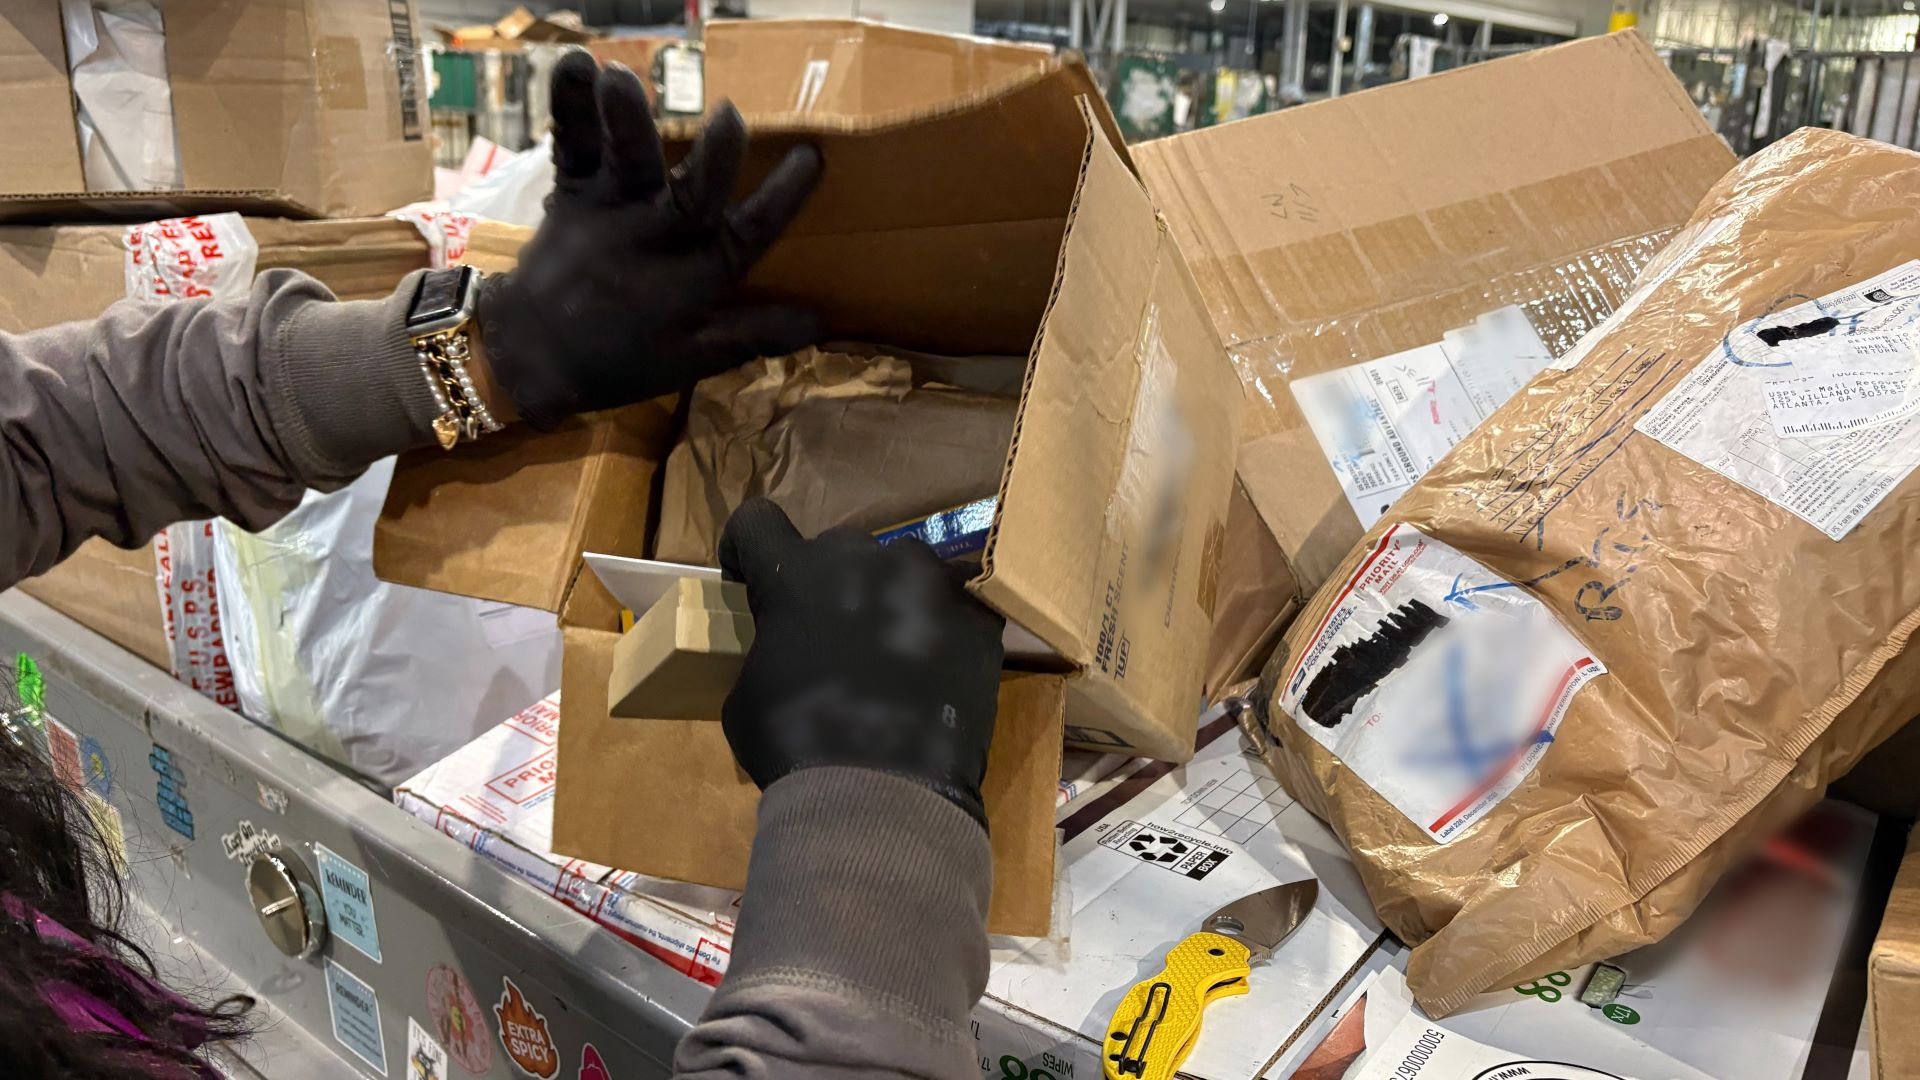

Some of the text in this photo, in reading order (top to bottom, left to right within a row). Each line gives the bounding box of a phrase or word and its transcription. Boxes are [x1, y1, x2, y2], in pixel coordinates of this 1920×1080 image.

[1800, 390, 1864, 400] VILLANOVA
[1392, 439, 1415, 475] GROUND
[1359, 541, 1400, 591] PRIORITY
[1374, 559, 1399, 585] MAIL
[1101, 538, 1128, 673] FRESH SCENT
[1095, 580, 1115, 664] 100/1 CT
[1325, 606, 1347, 637] STATES
[1307, 609, 1354, 671] POSTAL SERVICE
[1116, 641, 1129, 678] UP
[1553, 671, 1588, 716] INTERNATIONL
[1587, 664, 1601, 675] USE
[1366, 713, 1384, 728] TO:
[503, 760, 555, 788] PRIO
[1439, 824, 1456, 839] Label
[1463, 799, 1488, 821] December
[1147, 821, 1234, 855] how2recycle.info
[1180, 851, 1208, 870] PAPER
[1199, 858, 1218, 873] BOX
[507, 1020, 546, 1045] EXTRA
[510, 1038, 550, 1064] SPICY
[1042, 1052, 1074, 1080] WIPES
